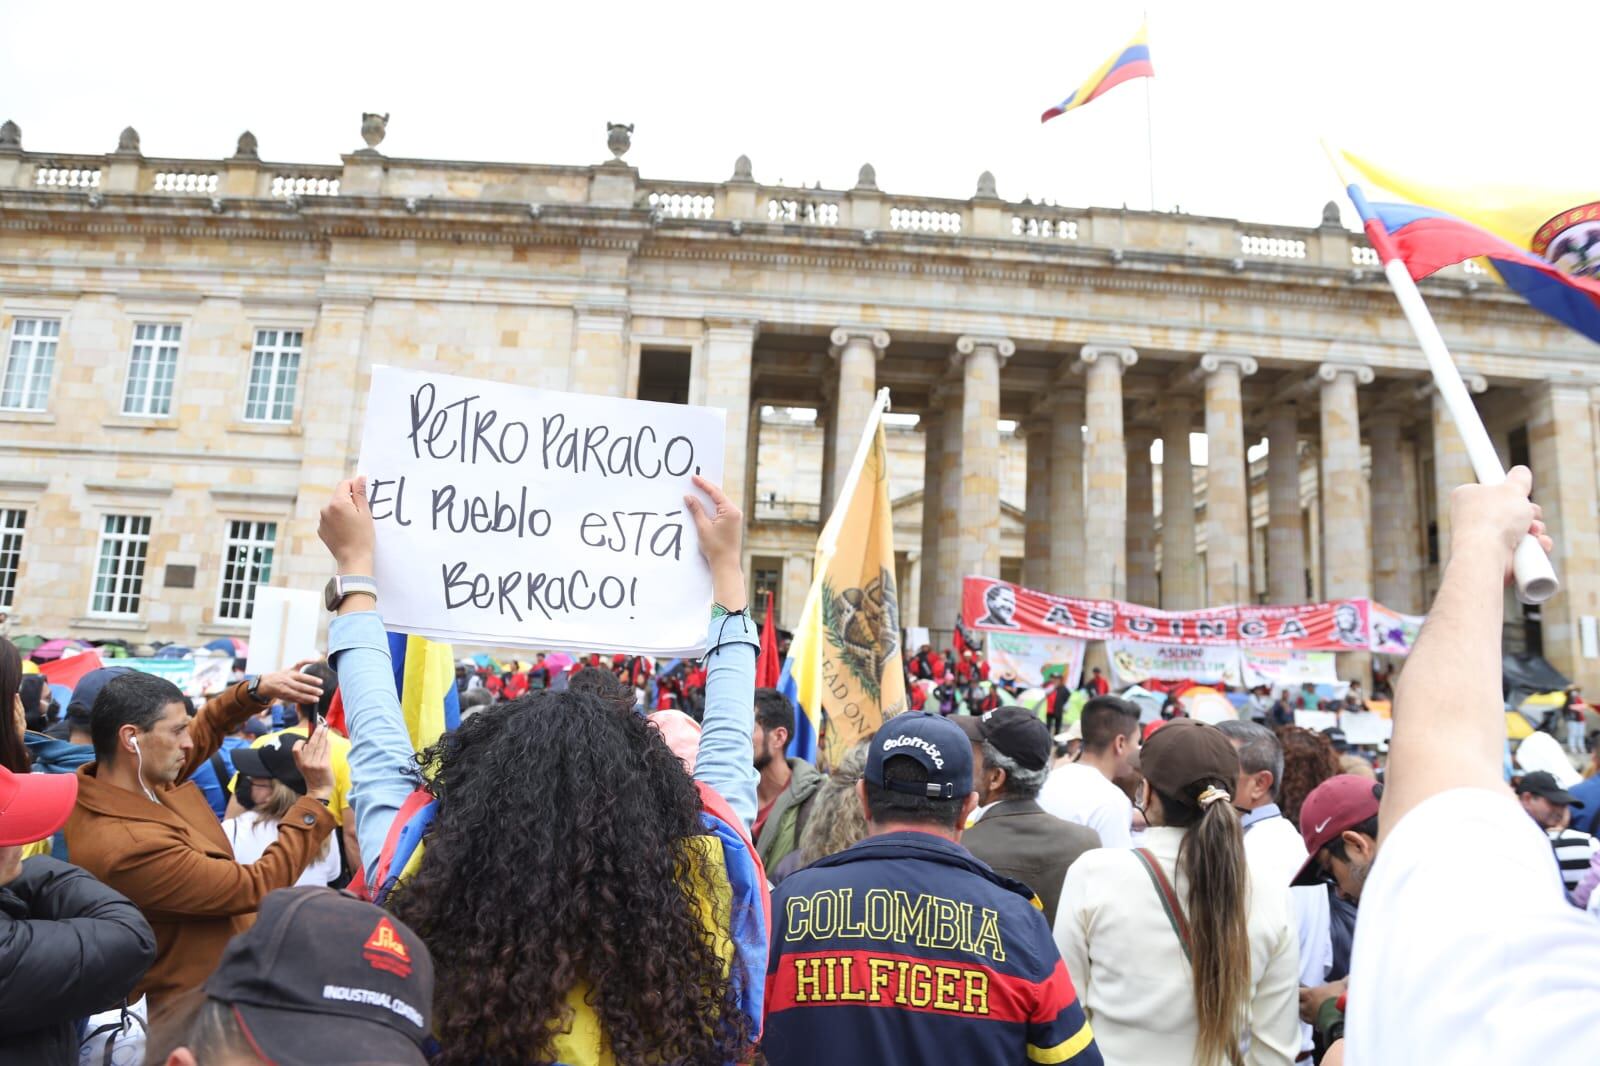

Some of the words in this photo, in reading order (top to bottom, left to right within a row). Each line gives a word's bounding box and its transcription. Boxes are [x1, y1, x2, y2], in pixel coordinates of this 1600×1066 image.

[822, 652, 848, 700] EAD
[843, 702, 871, 734] ON
[785, 888, 1006, 962] COLOMBIA
[323, 985, 392, 1010] INDUSTRIAL
[794, 957, 991, 1014] HILFIGER
